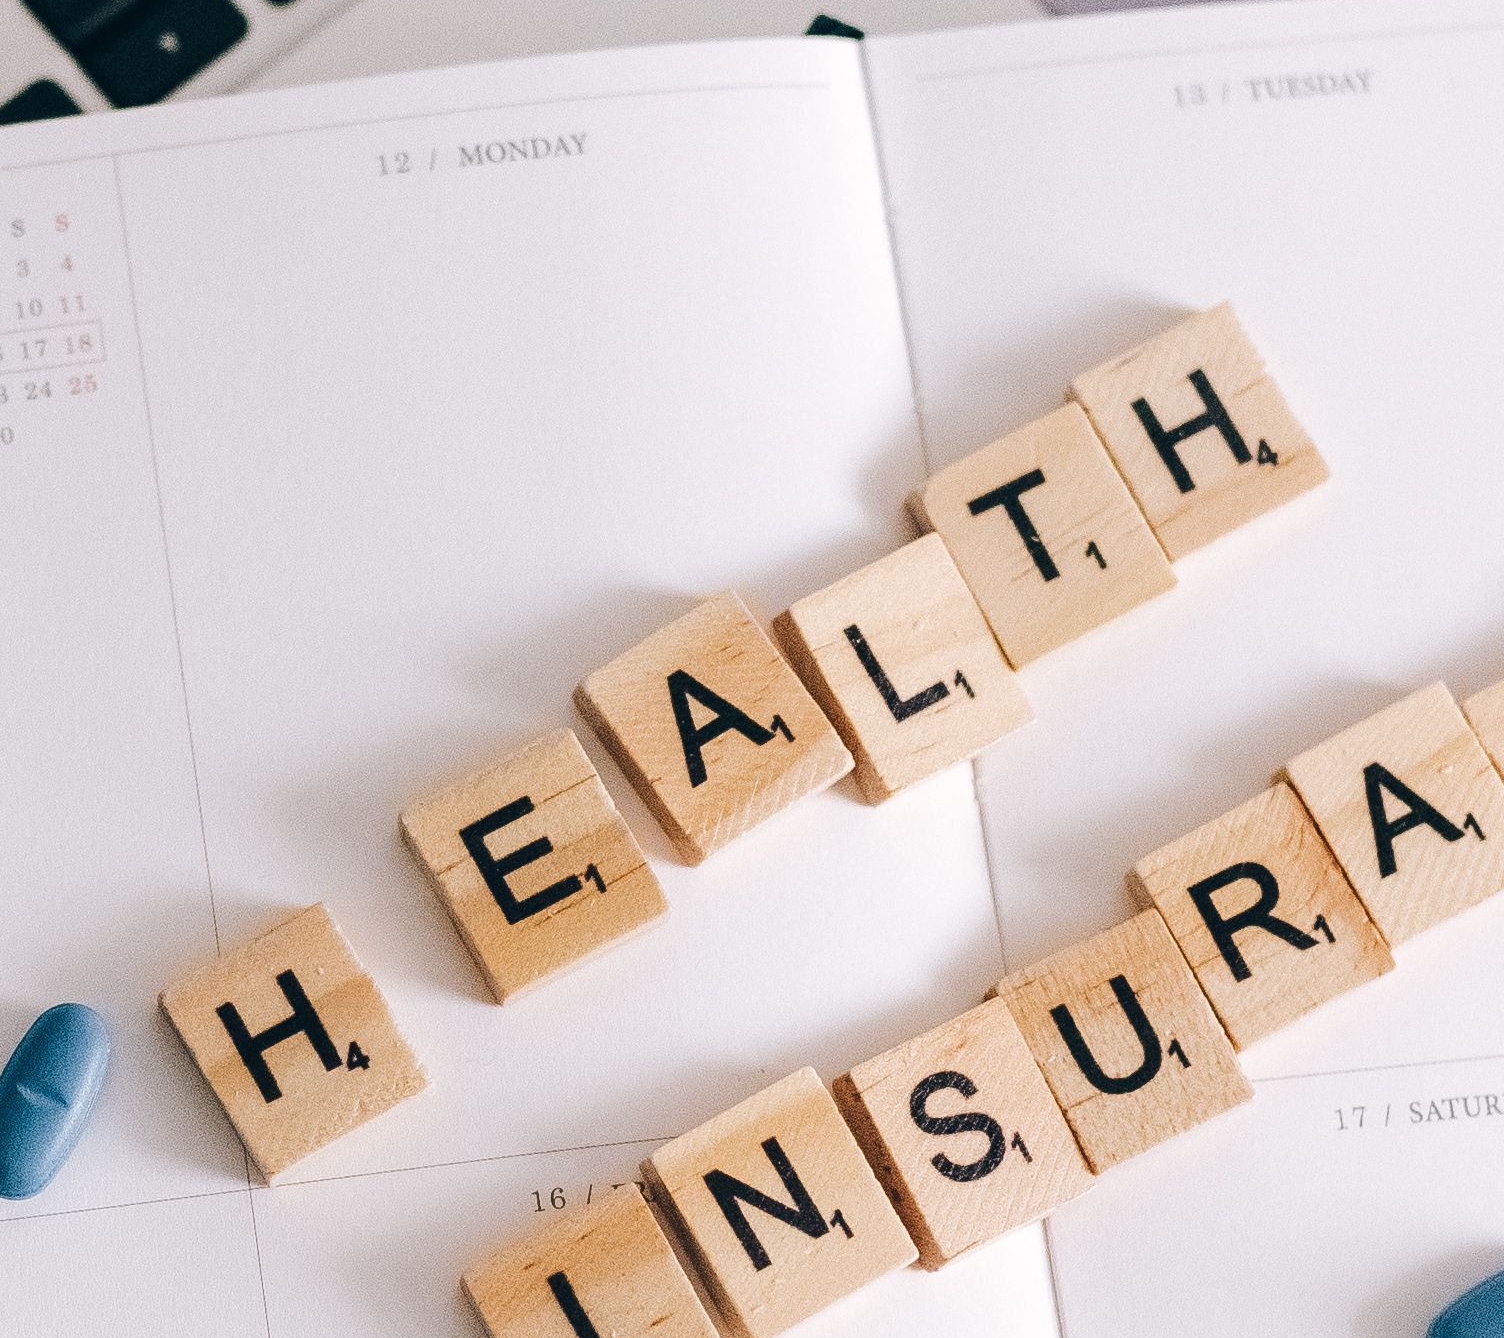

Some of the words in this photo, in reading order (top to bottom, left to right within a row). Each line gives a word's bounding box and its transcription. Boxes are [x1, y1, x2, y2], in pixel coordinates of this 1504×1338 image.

[1246, 71, 1372, 102] TUESDAY
[377, 151, 411, 177] 12
[458, 133, 587, 168] MONDAY
[21, 339, 47, 360] 17
[66, 334, 92, 355] 18
[24, 381, 52, 401] 24
[70, 374, 98, 395] 25
[1253, 439, 1278, 467] 4
[1084, 542, 1108, 570] 1
[954, 670, 975, 699] 1
[770, 714, 795, 743] 1
[1462, 814, 1485, 842] 1
[583, 863, 608, 894] 1
[1311, 914, 1336, 943] 1
[340, 1041, 370, 1071] 4
[1167, 1039, 1192, 1069] 1
[1335, 1106, 1366, 1131] 17
[1011, 1132, 1033, 1163] 1
[532, 1187, 566, 1212] 16
[829, 1208, 854, 1239] 1
